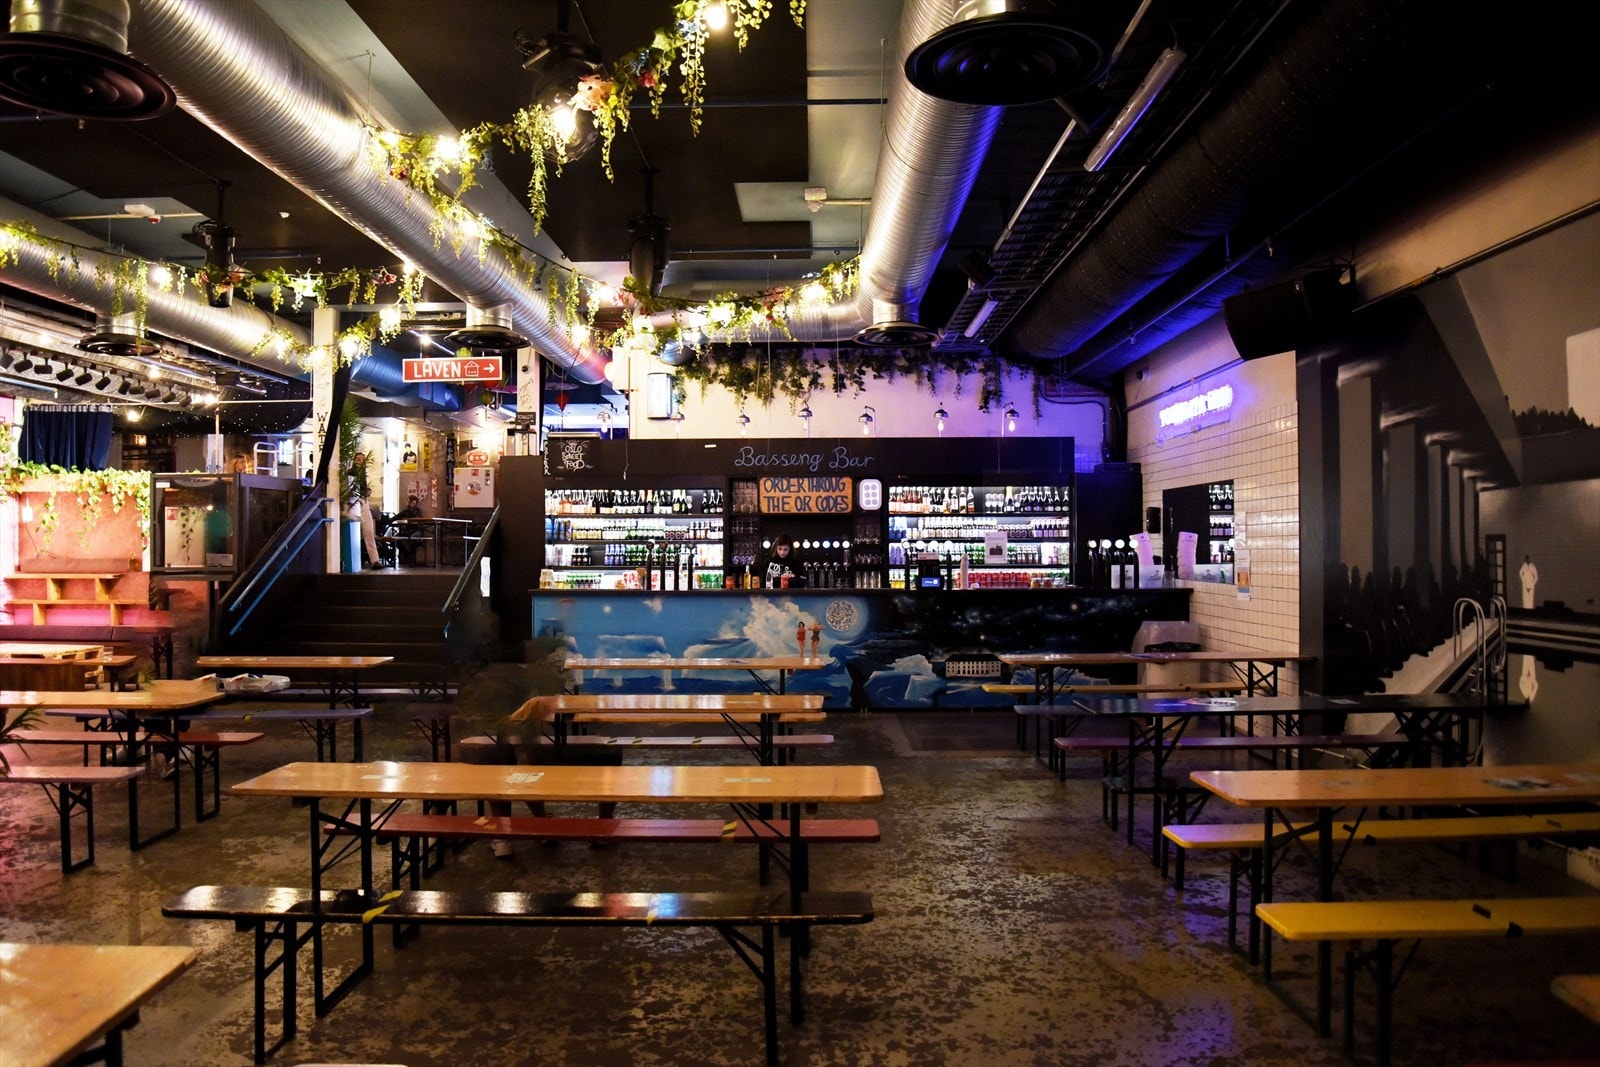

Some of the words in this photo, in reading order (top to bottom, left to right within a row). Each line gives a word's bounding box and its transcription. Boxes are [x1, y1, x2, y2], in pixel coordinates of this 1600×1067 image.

[564, 445, 582, 453] OSLO
[564, 460, 585, 471] FOOD
[734, 446, 824, 472] Basseng
[829, 446, 875, 469] Bar
[764, 477, 806, 493] ORDER
[763, 495, 792, 512] THE
[795, 495, 812, 512] QR
[816, 495, 849, 512] CODES
